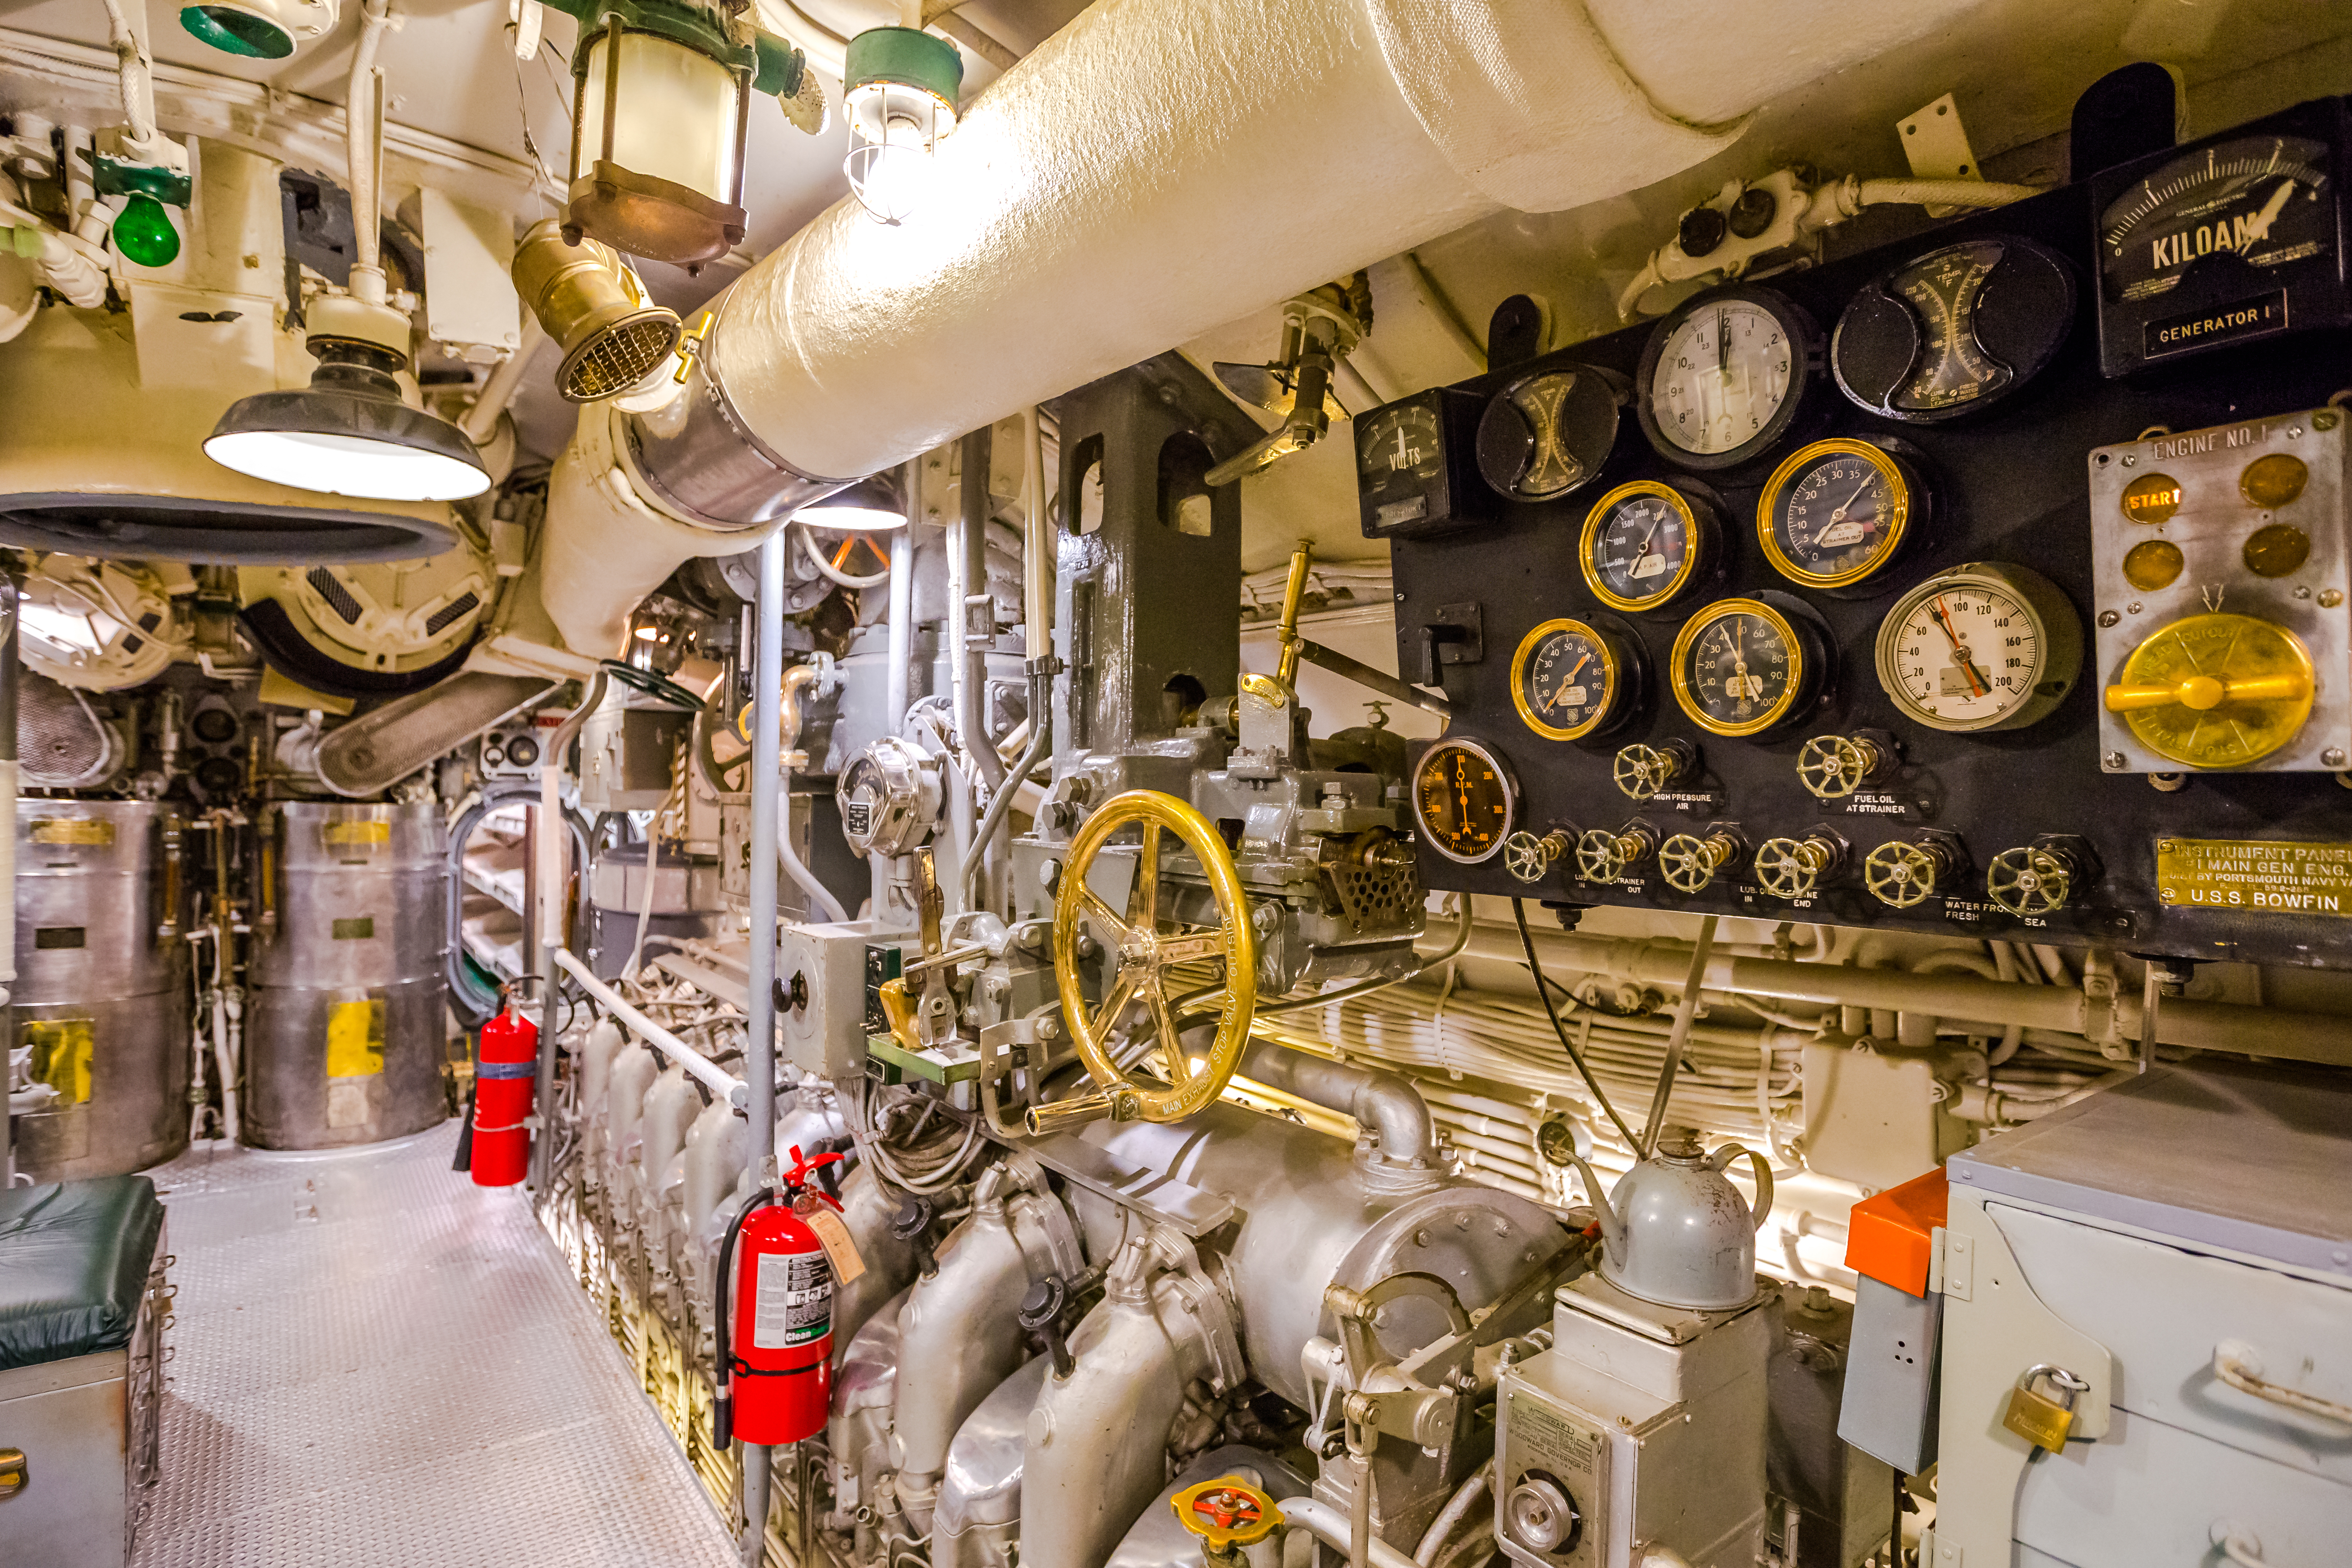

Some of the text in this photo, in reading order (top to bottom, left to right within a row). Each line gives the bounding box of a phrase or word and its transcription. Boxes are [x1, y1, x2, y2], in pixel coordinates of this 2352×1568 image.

[2115, 248, 2122, 256] 0
[1751, 317, 1755, 328] 1
[2160, 308, 2257, 343] GENERATOR
[1697, 332, 1703, 344] 11
[1771, 333, 1778, 345] 2
[1701, 342, 1710, 350] 23
[1677, 356, 1688, 369] 10
[1780, 361, 1788, 373] 3
[1670, 387, 1677, 398] 9
[1772, 393, 1779, 404] 4
[1679, 412, 1686, 423] 8
[1751, 418, 1758, 429] 5
[1700, 428, 1706, 439] 7
[1724, 431, 1732, 442] 6
[2154, 427, 2255, 460] ENGINE NO.
[1389, 447, 1421, 471] VOTS
[1831, 469, 1843, 480] 30
[1849, 469, 1860, 480] 35
[1816, 476, 1827, 487] 25
[1805, 489, 1817, 500] 20
[1871, 489, 1883, 498] 45
[2129, 488, 2181, 509] START
[1635, 508, 1649, 518] 2000
[1798, 506, 1807, 515] 15
[1875, 502, 1889, 513] 50
[1621, 518, 1635, 529] 1500
[1664, 523, 1678, 534] 3000
[1797, 520, 1807, 529] 10
[1613, 536, 1626, 545] 1000
[1803, 534, 1809, 543] 5
[1864, 544, 1878, 555] 60
[1615, 557, 1624, 566] 500
[1812, 553, 1818, 561] 0
[1667, 560, 1681, 570] 4000
[1953, 601, 1968, 613] 100
[1976, 604, 1992, 616] 120
[1993, 617, 2009, 628] 140
[1753, 629, 1765, 638] 60
[1916, 626, 1927, 636] 60
[1564, 643, 1573, 651] 50
[1764, 639, 1776, 649] 70
[2005, 636, 2022, 647] 160
[1550, 648, 1560, 656] 40
[1577, 645, 1587, 654] 60
[1710, 645, 1721, 654] 30
[1909, 646, 1919, 656] 40
[1544, 660, 1552, 668] 30
[1771, 654, 1784, 663] 80
[2005, 657, 2021, 668] 180
[1704, 660, 1715, 669] 20
[1592, 667, 1602, 676] 80
[1770, 671, 1783, 680] 90
[1913, 667, 1924, 677] 20
[1592, 682, 1602, 690] 90
[1707, 677, 1716, 686] 10
[1925, 681, 1931, 691] 0
[1995, 676, 2013, 687] 200
[1542, 689, 1550, 697] 10
[1760, 697, 1775, 707] 100
[1584, 706, 1596, 715] 100
[1483, 771, 1493, 780] 200
[1672, 794, 1712, 802] PRESSURE
[1854, 795, 1895, 804] FUEL OIL
[1846, 804, 1906, 814] AT STRAINER
[2175, 845, 2352, 862] INSTRUMENT PANEL
[2208, 860, 2350, 877] MAIN GEN ENG.
[1613, 877, 1645, 886] TRAINER
[2197, 873, 2213, 881] BY
[2215, 873, 2298, 885] PORTSMOUTH
[2302, 876, 2336, 887] NAVY
[1056, 875, 1068, 908] CLOSE
[1794, 899, 1811, 907] END
[2191, 889, 2338, 911] U.S.S. BOWFIN
[1945, 901, 2008, 913] WATER FRO
[1946, 911, 2046, 927] FRESH SEA
[1162, 1101, 1183, 1115] MAIN
[1182, 1064, 1215, 1106] EXHAUST
[1213, 1030, 1227, 1064] STOP
[1224, 984, 1238, 1026] VALVE
[1509, 1428, 1545, 1451] WOODWARD
[1547, 1447, 1581, 1469] GOVERNOR
